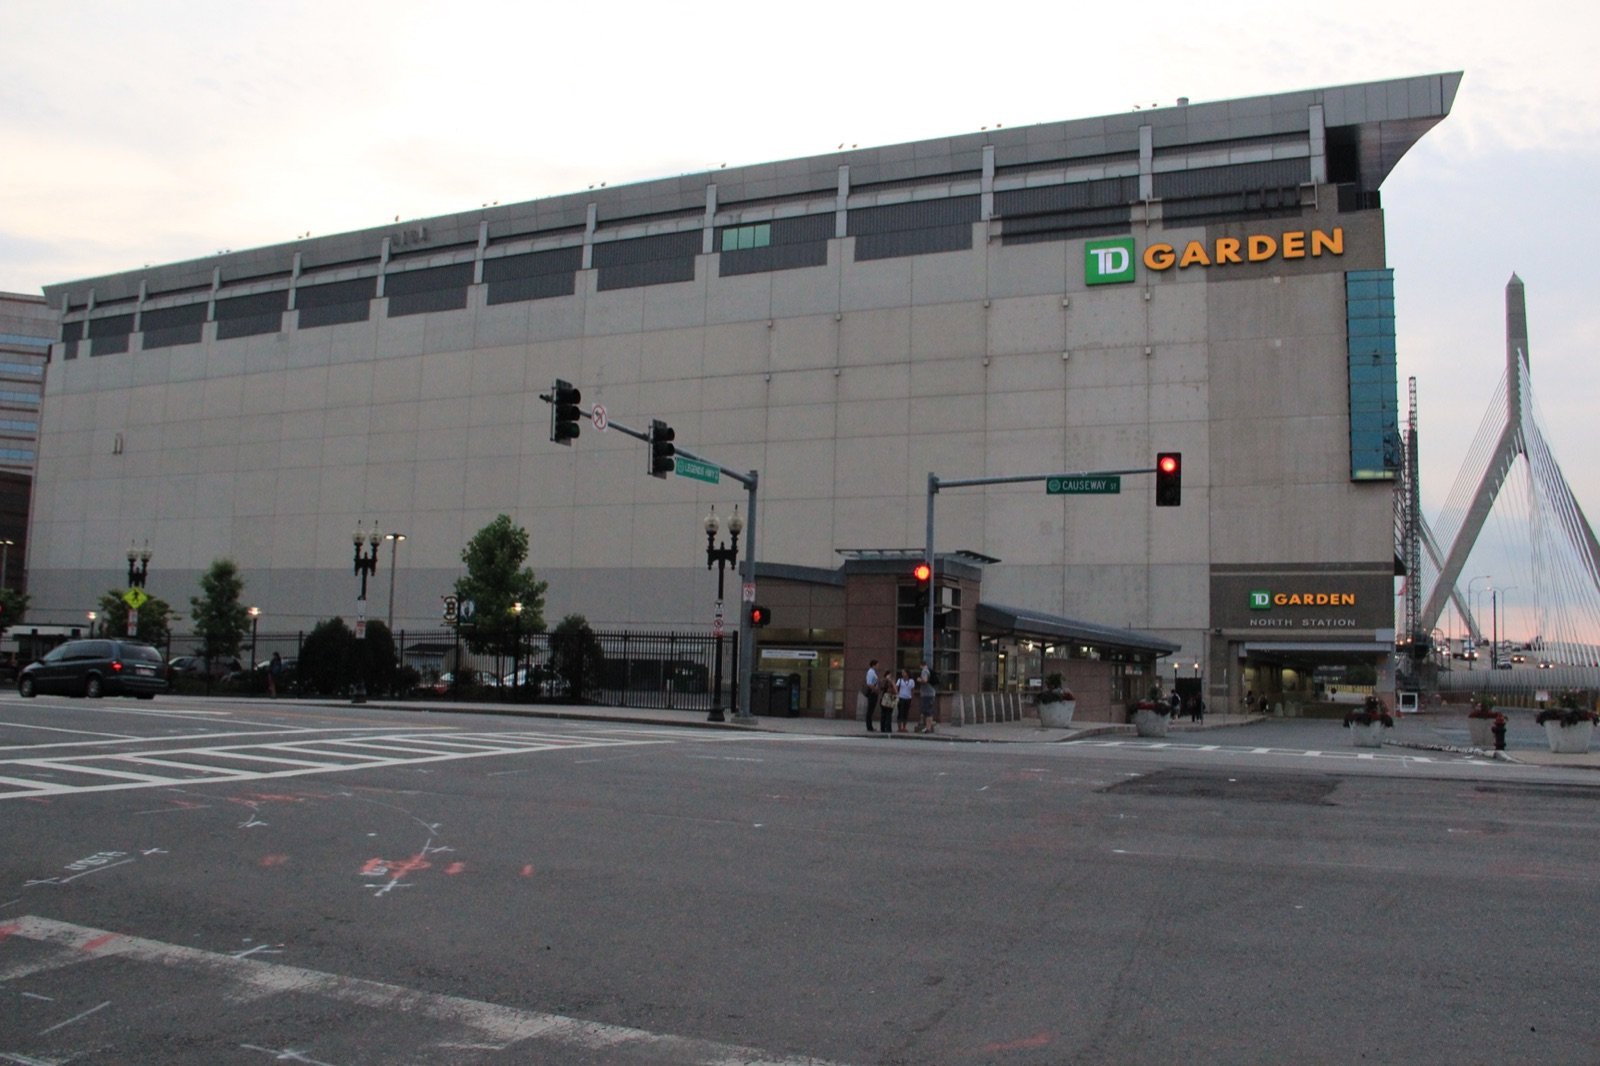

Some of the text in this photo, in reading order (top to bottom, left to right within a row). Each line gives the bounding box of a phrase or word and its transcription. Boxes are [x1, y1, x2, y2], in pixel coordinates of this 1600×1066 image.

[1090, 227, 1344, 275] TD GARDEN
[1062, 480, 1107, 491] CAUSEWAY
[1252, 593, 1355, 606] TD GARDEN
